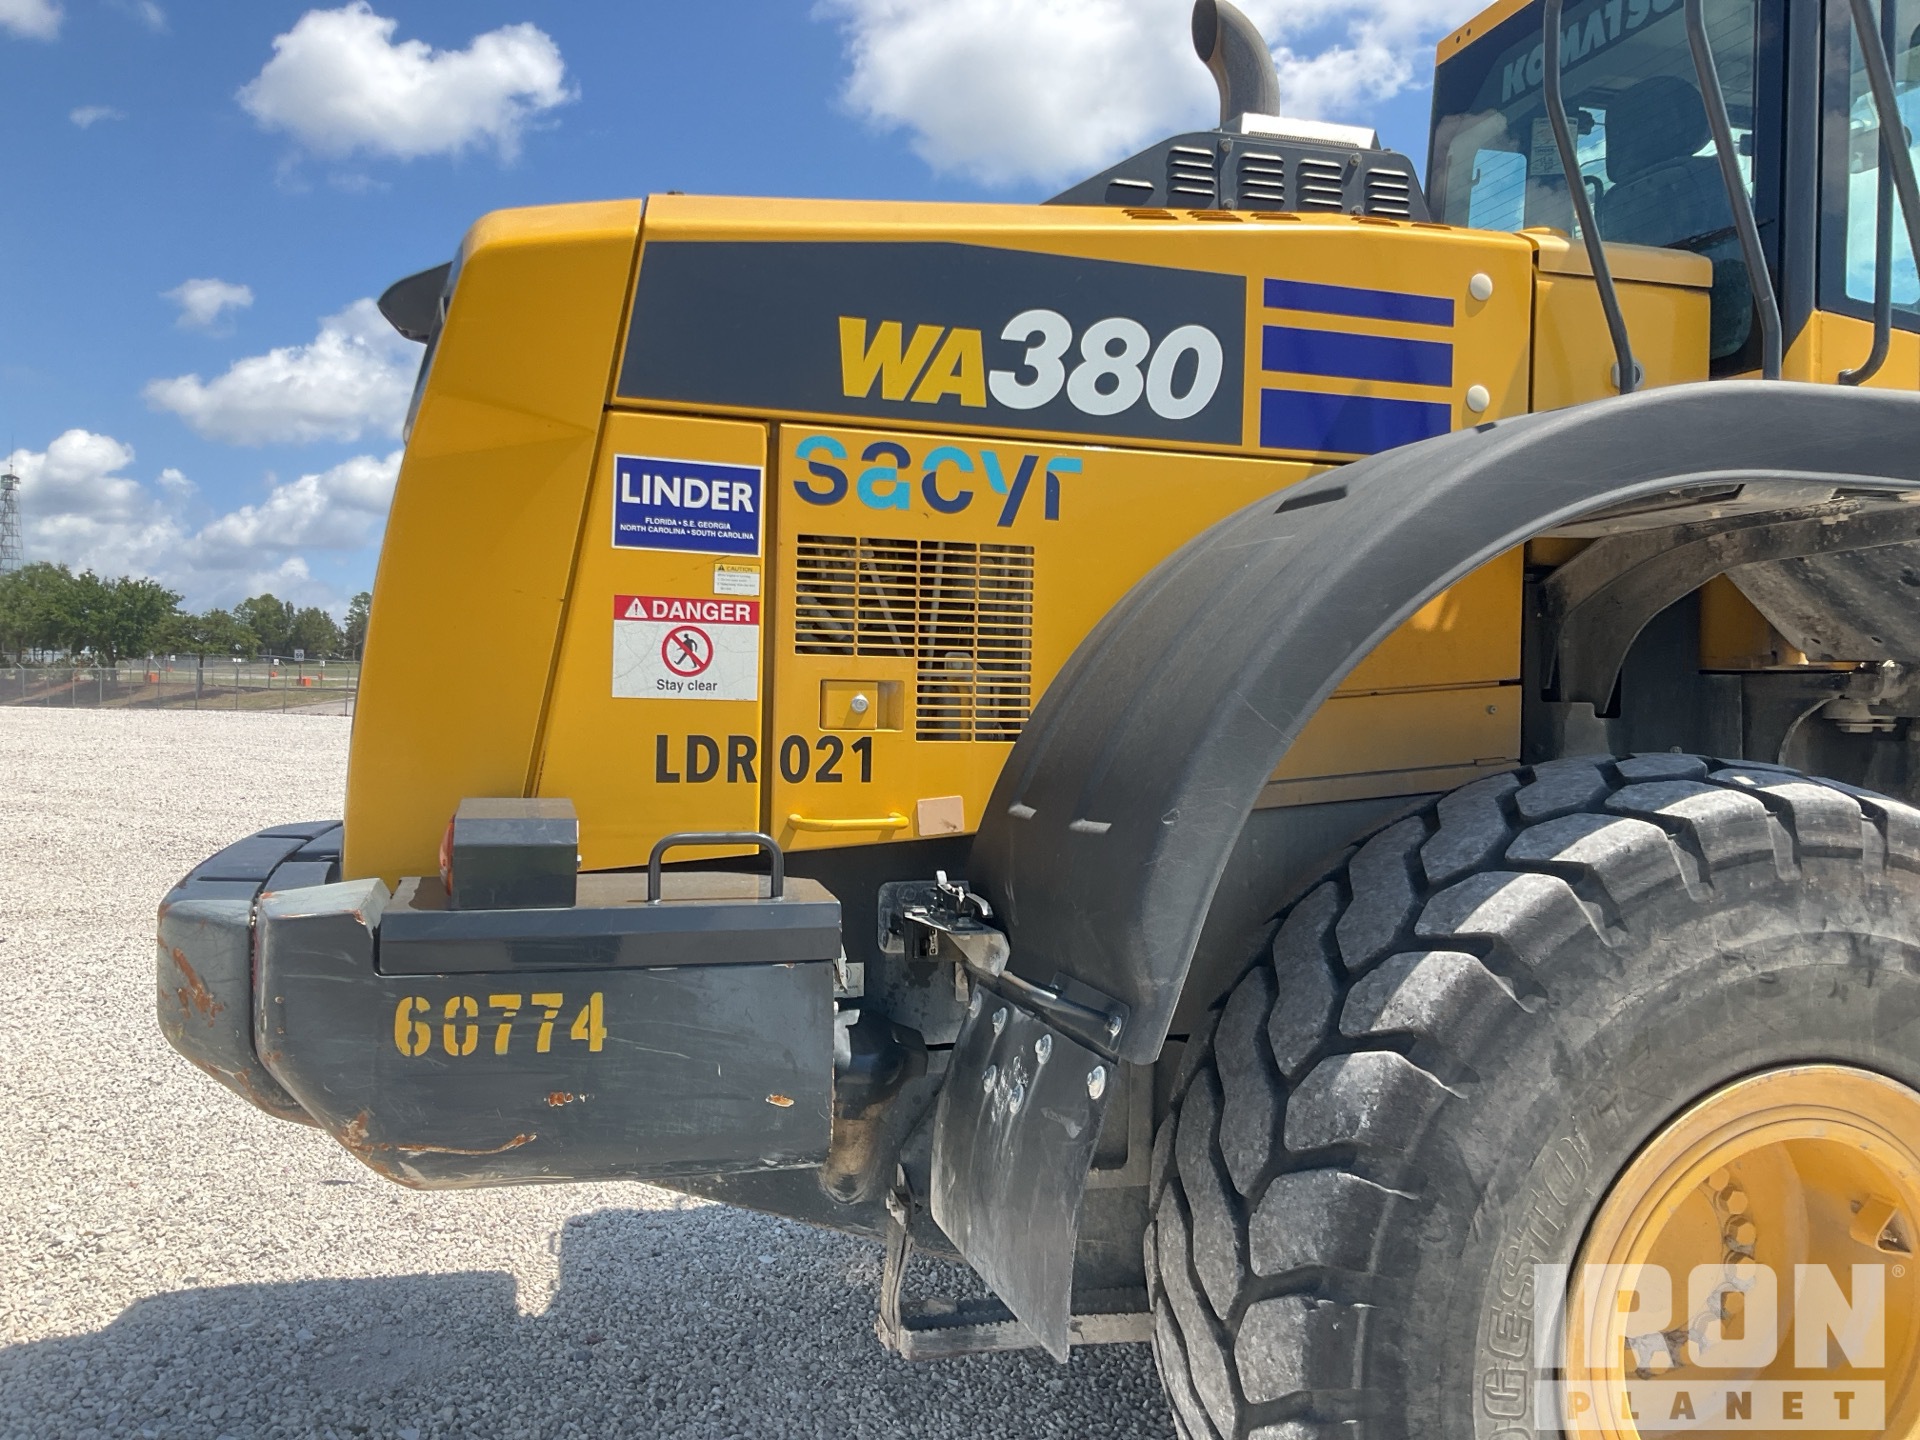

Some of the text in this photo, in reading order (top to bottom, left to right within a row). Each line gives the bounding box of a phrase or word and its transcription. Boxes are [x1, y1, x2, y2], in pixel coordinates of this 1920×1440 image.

[1502, 0, 1674, 103] KOMATS
[839, 309, 1224, 420] WA380
[621, 472, 755, 513] LINDER
[794, 436, 1082, 526] sacyr
[620, 524, 755, 540] NORTH CAROLINA SOUTH CAROLINA
[645, 517, 731, 530] FLORIDA S.E. GEORGIA
[652, 600, 751, 622] DANGER
[656, 679, 718, 694] Stay clear
[655, 734, 873, 784] LDR 021
[393, 991, 606, 1057] 60774
